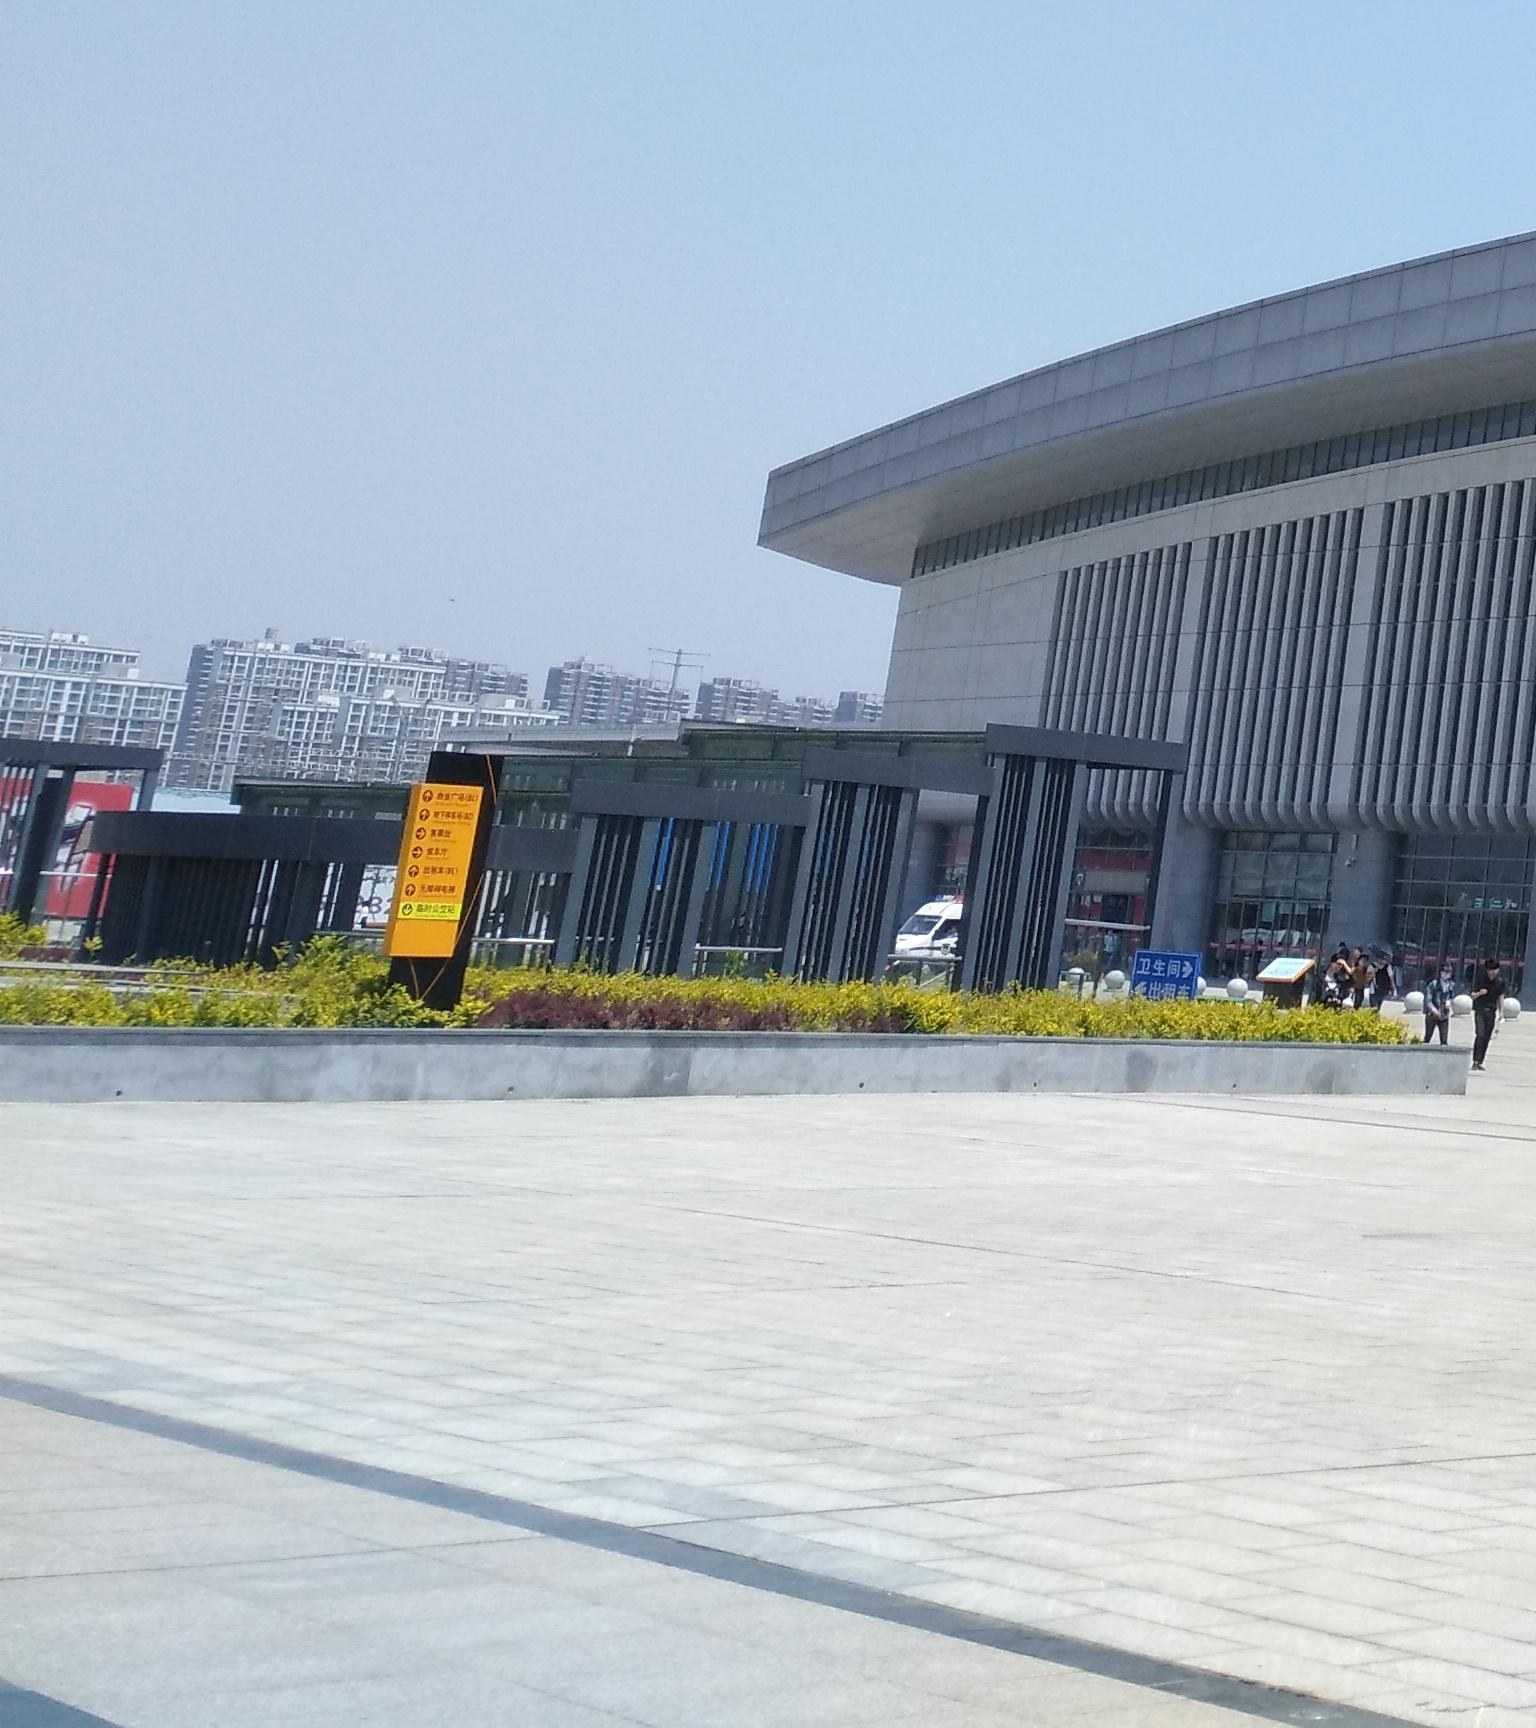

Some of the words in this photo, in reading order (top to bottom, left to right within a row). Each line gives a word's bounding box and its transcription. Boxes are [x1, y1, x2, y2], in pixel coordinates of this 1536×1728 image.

[1136, 958, 1181, 978] 卫生间
[1149, 980, 1191, 1000] 出租车
